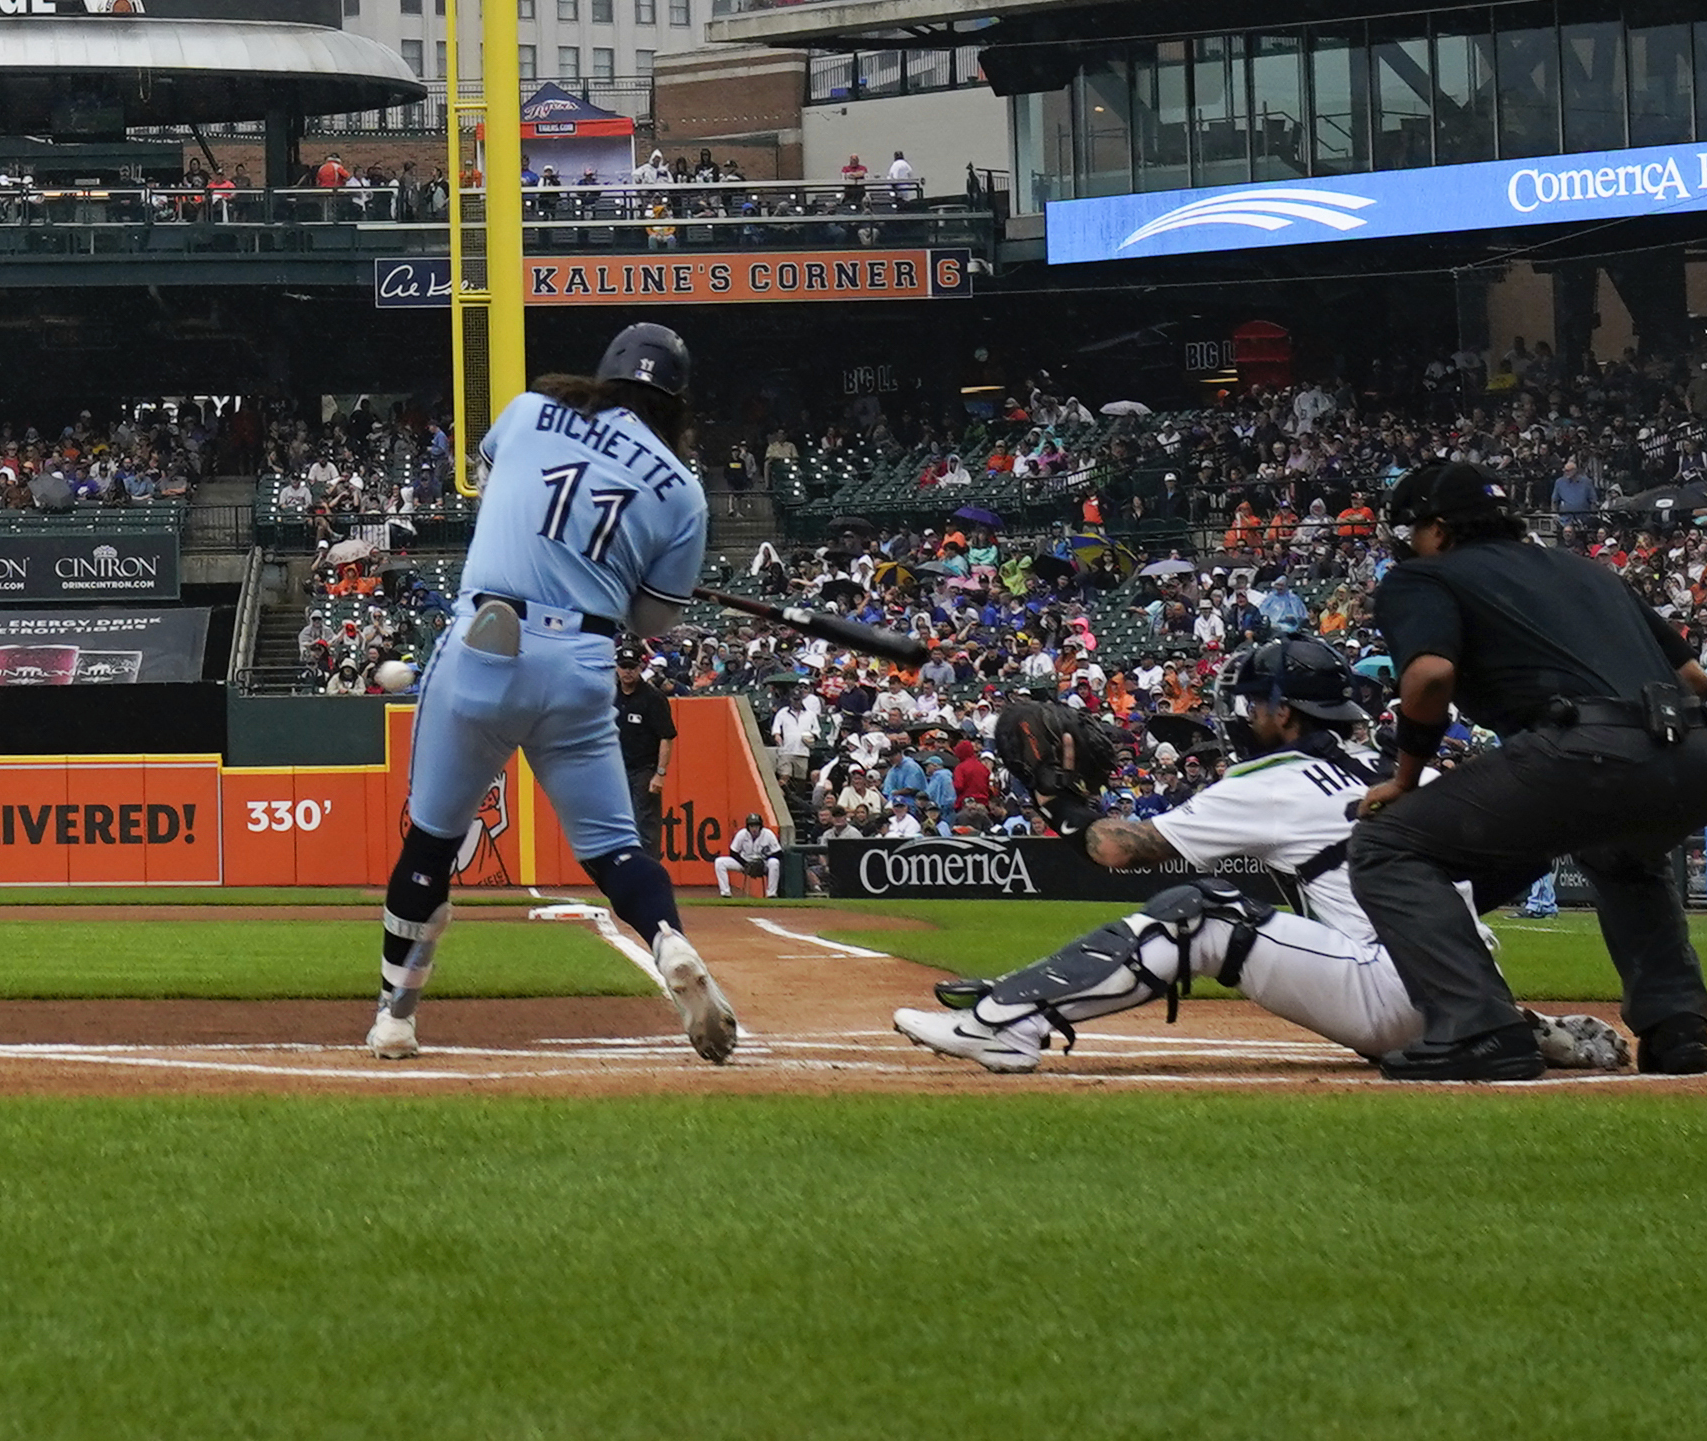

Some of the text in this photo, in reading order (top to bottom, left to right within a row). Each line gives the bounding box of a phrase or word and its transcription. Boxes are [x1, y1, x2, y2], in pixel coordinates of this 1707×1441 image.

[531, 258, 962, 296] KALINE'S CORNER 6
[1186, 340, 1219, 371] BIG
[842, 366, 875, 395] BIG
[535, 402, 687, 503] BICHETTE
[55, 555, 157, 579] CINTRON
[61, 580, 155, 590] DRINKCINTRON.COM
[9, 618, 91, 628] ENERGY
[95, 616, 162, 627] DRINK
[75, 624, 146, 634] TIGERS
[246, 799, 332, 834] 330'
